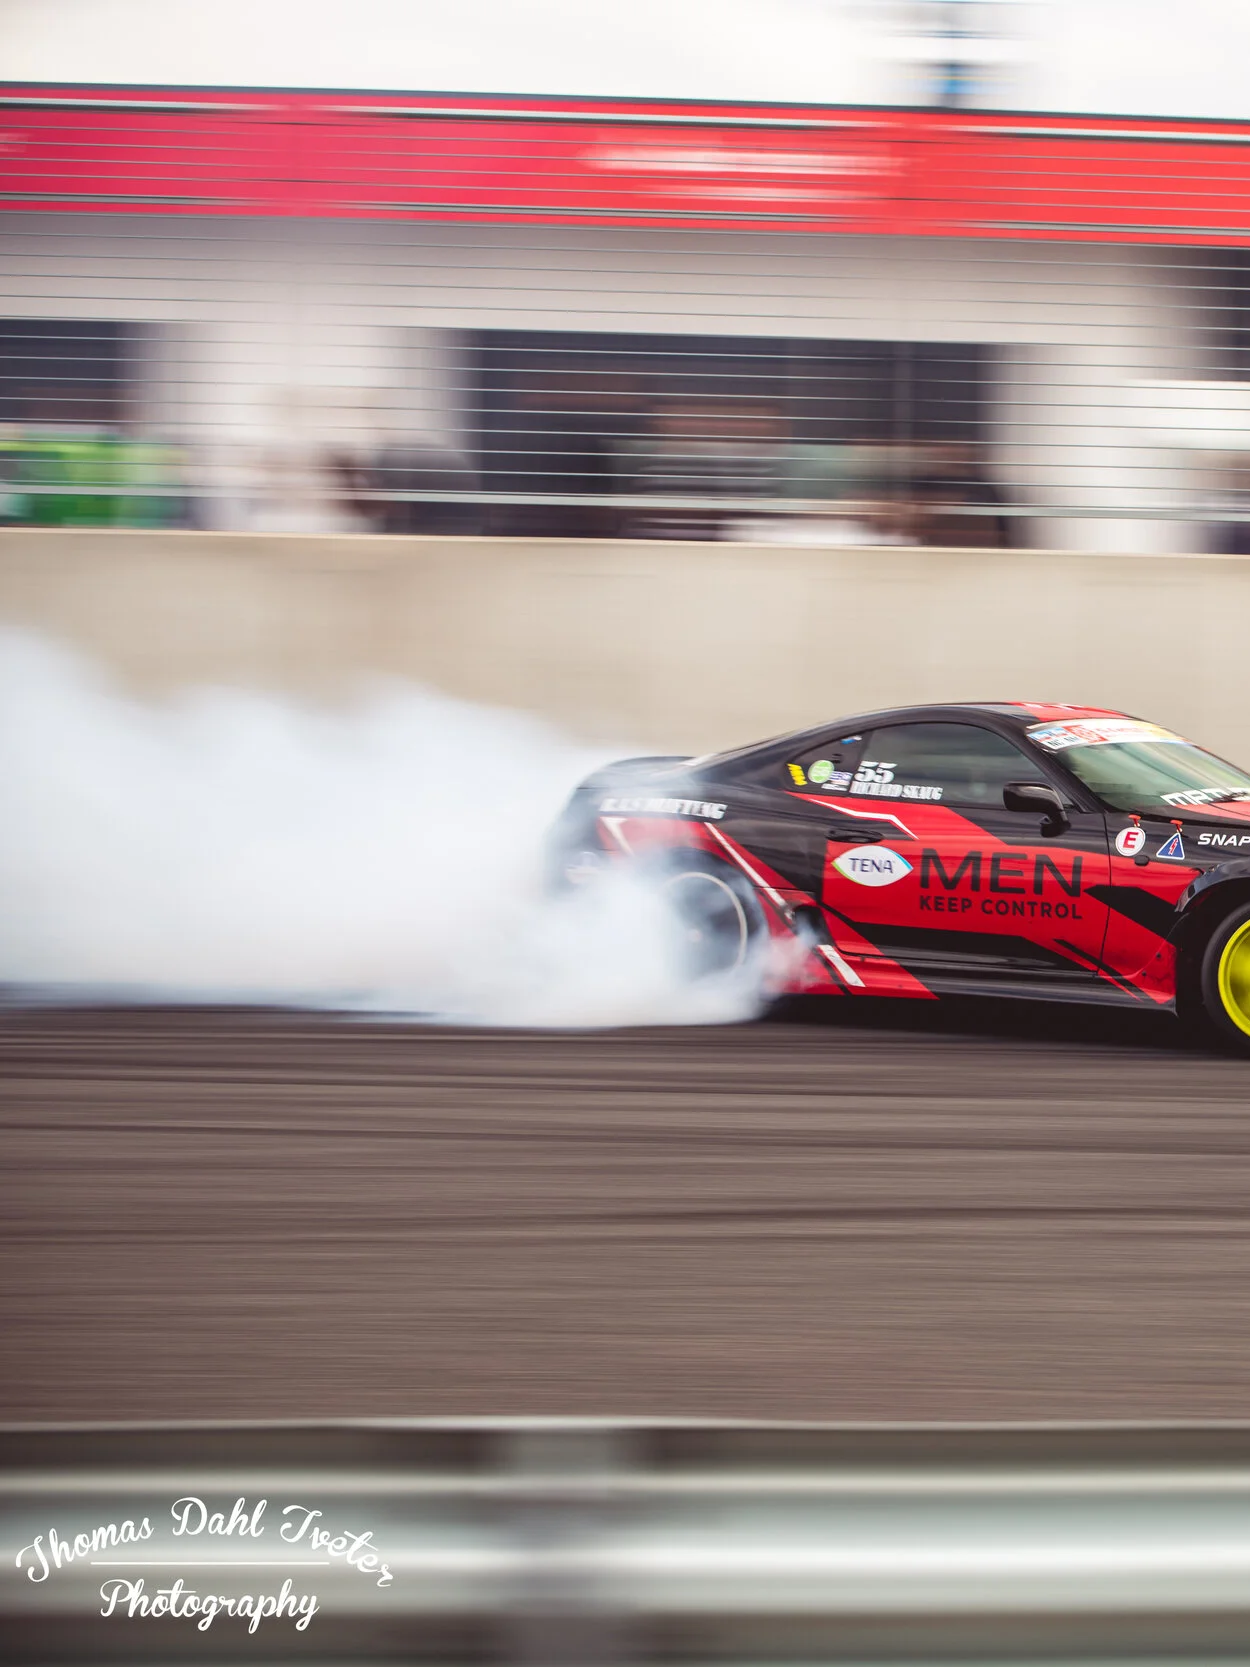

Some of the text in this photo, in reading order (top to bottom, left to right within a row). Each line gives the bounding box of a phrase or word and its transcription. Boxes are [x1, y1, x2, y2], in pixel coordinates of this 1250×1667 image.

[854, 760, 898, 784] 55
[1123, 831, 1139, 849] E
[848, 857, 894, 874] TENA
[919, 848, 1083, 897] MEN
[919, 895, 1082, 920] KEEP CONTROL
